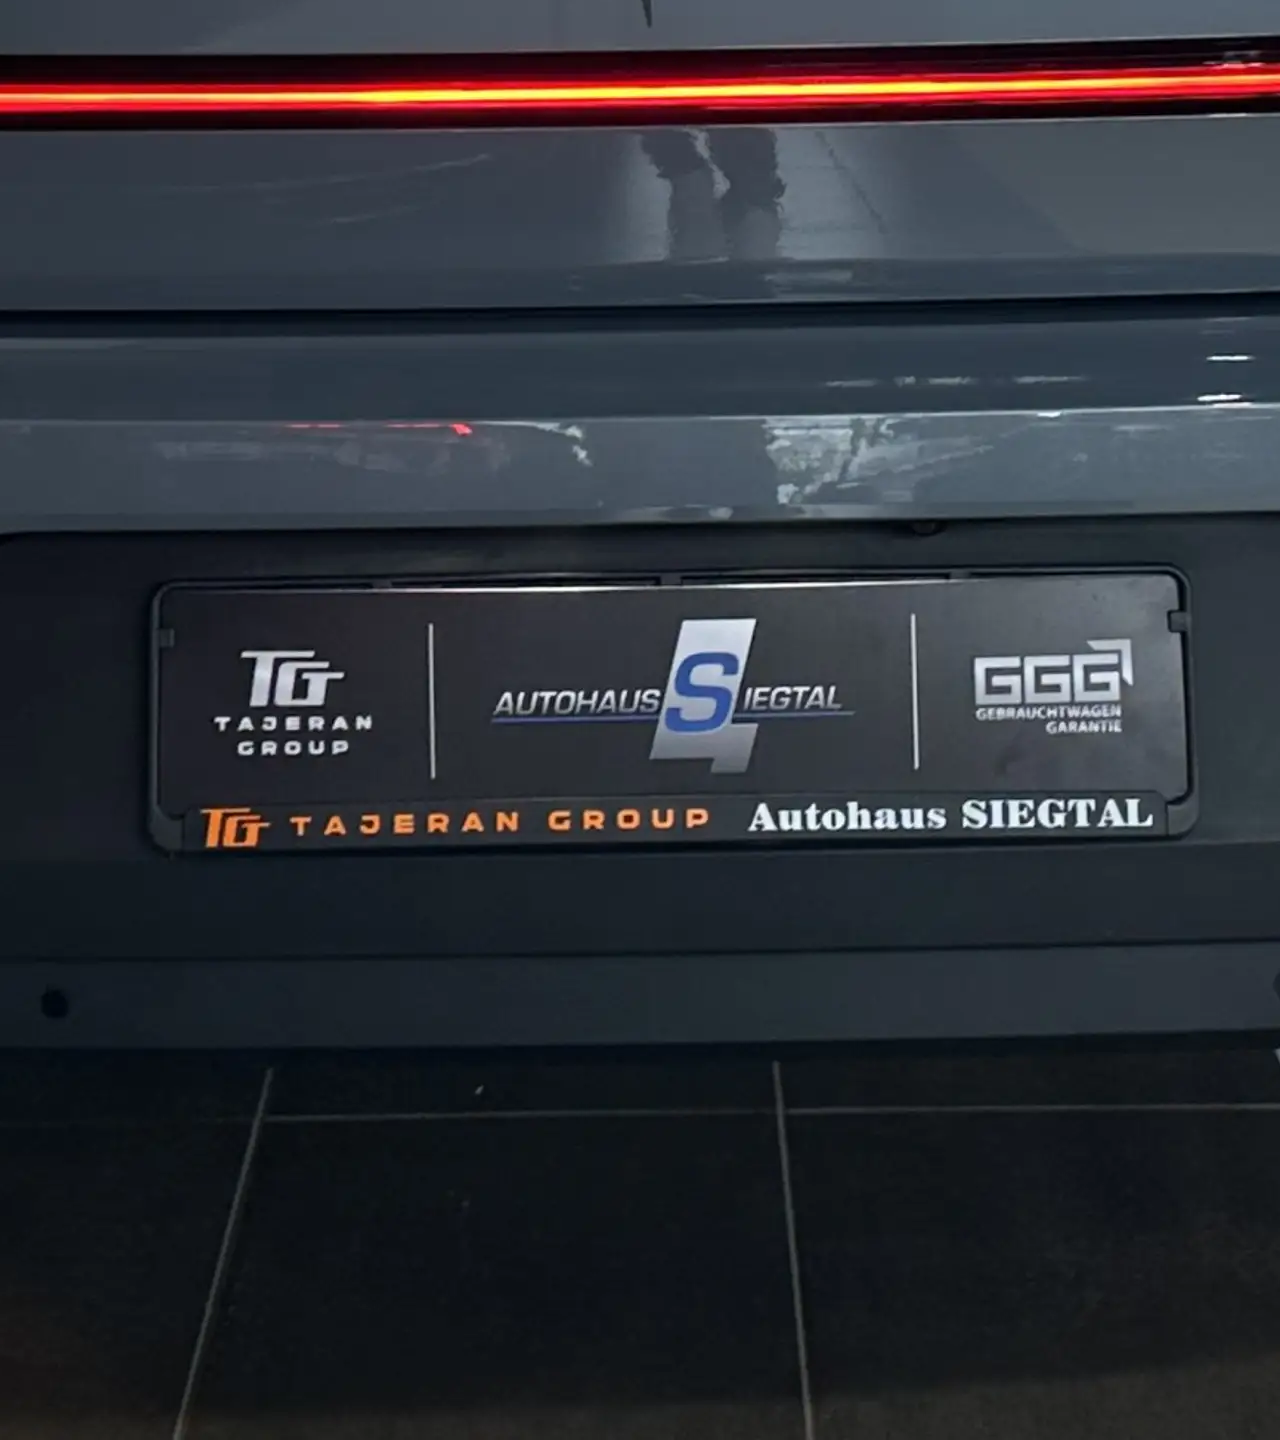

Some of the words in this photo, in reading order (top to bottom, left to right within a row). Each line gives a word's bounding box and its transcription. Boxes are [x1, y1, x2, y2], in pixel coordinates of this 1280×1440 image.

[974, 653, 1120, 705] GGG
[493, 689, 661, 716] AUTOHAUS
[975, 704, 1122, 721] GEBRAUCHTWAGEN
[214, 715, 373, 732] TAJERAN
[1045, 719, 1123, 735] GARANTIE
[237, 740, 349, 756] GROUP
[289, 810, 520, 837] TAJERAN
[547, 807, 709, 831] GROUP
[748, 801, 947, 831] Autohaus
[961, 798, 1154, 829] SIEGTAL
